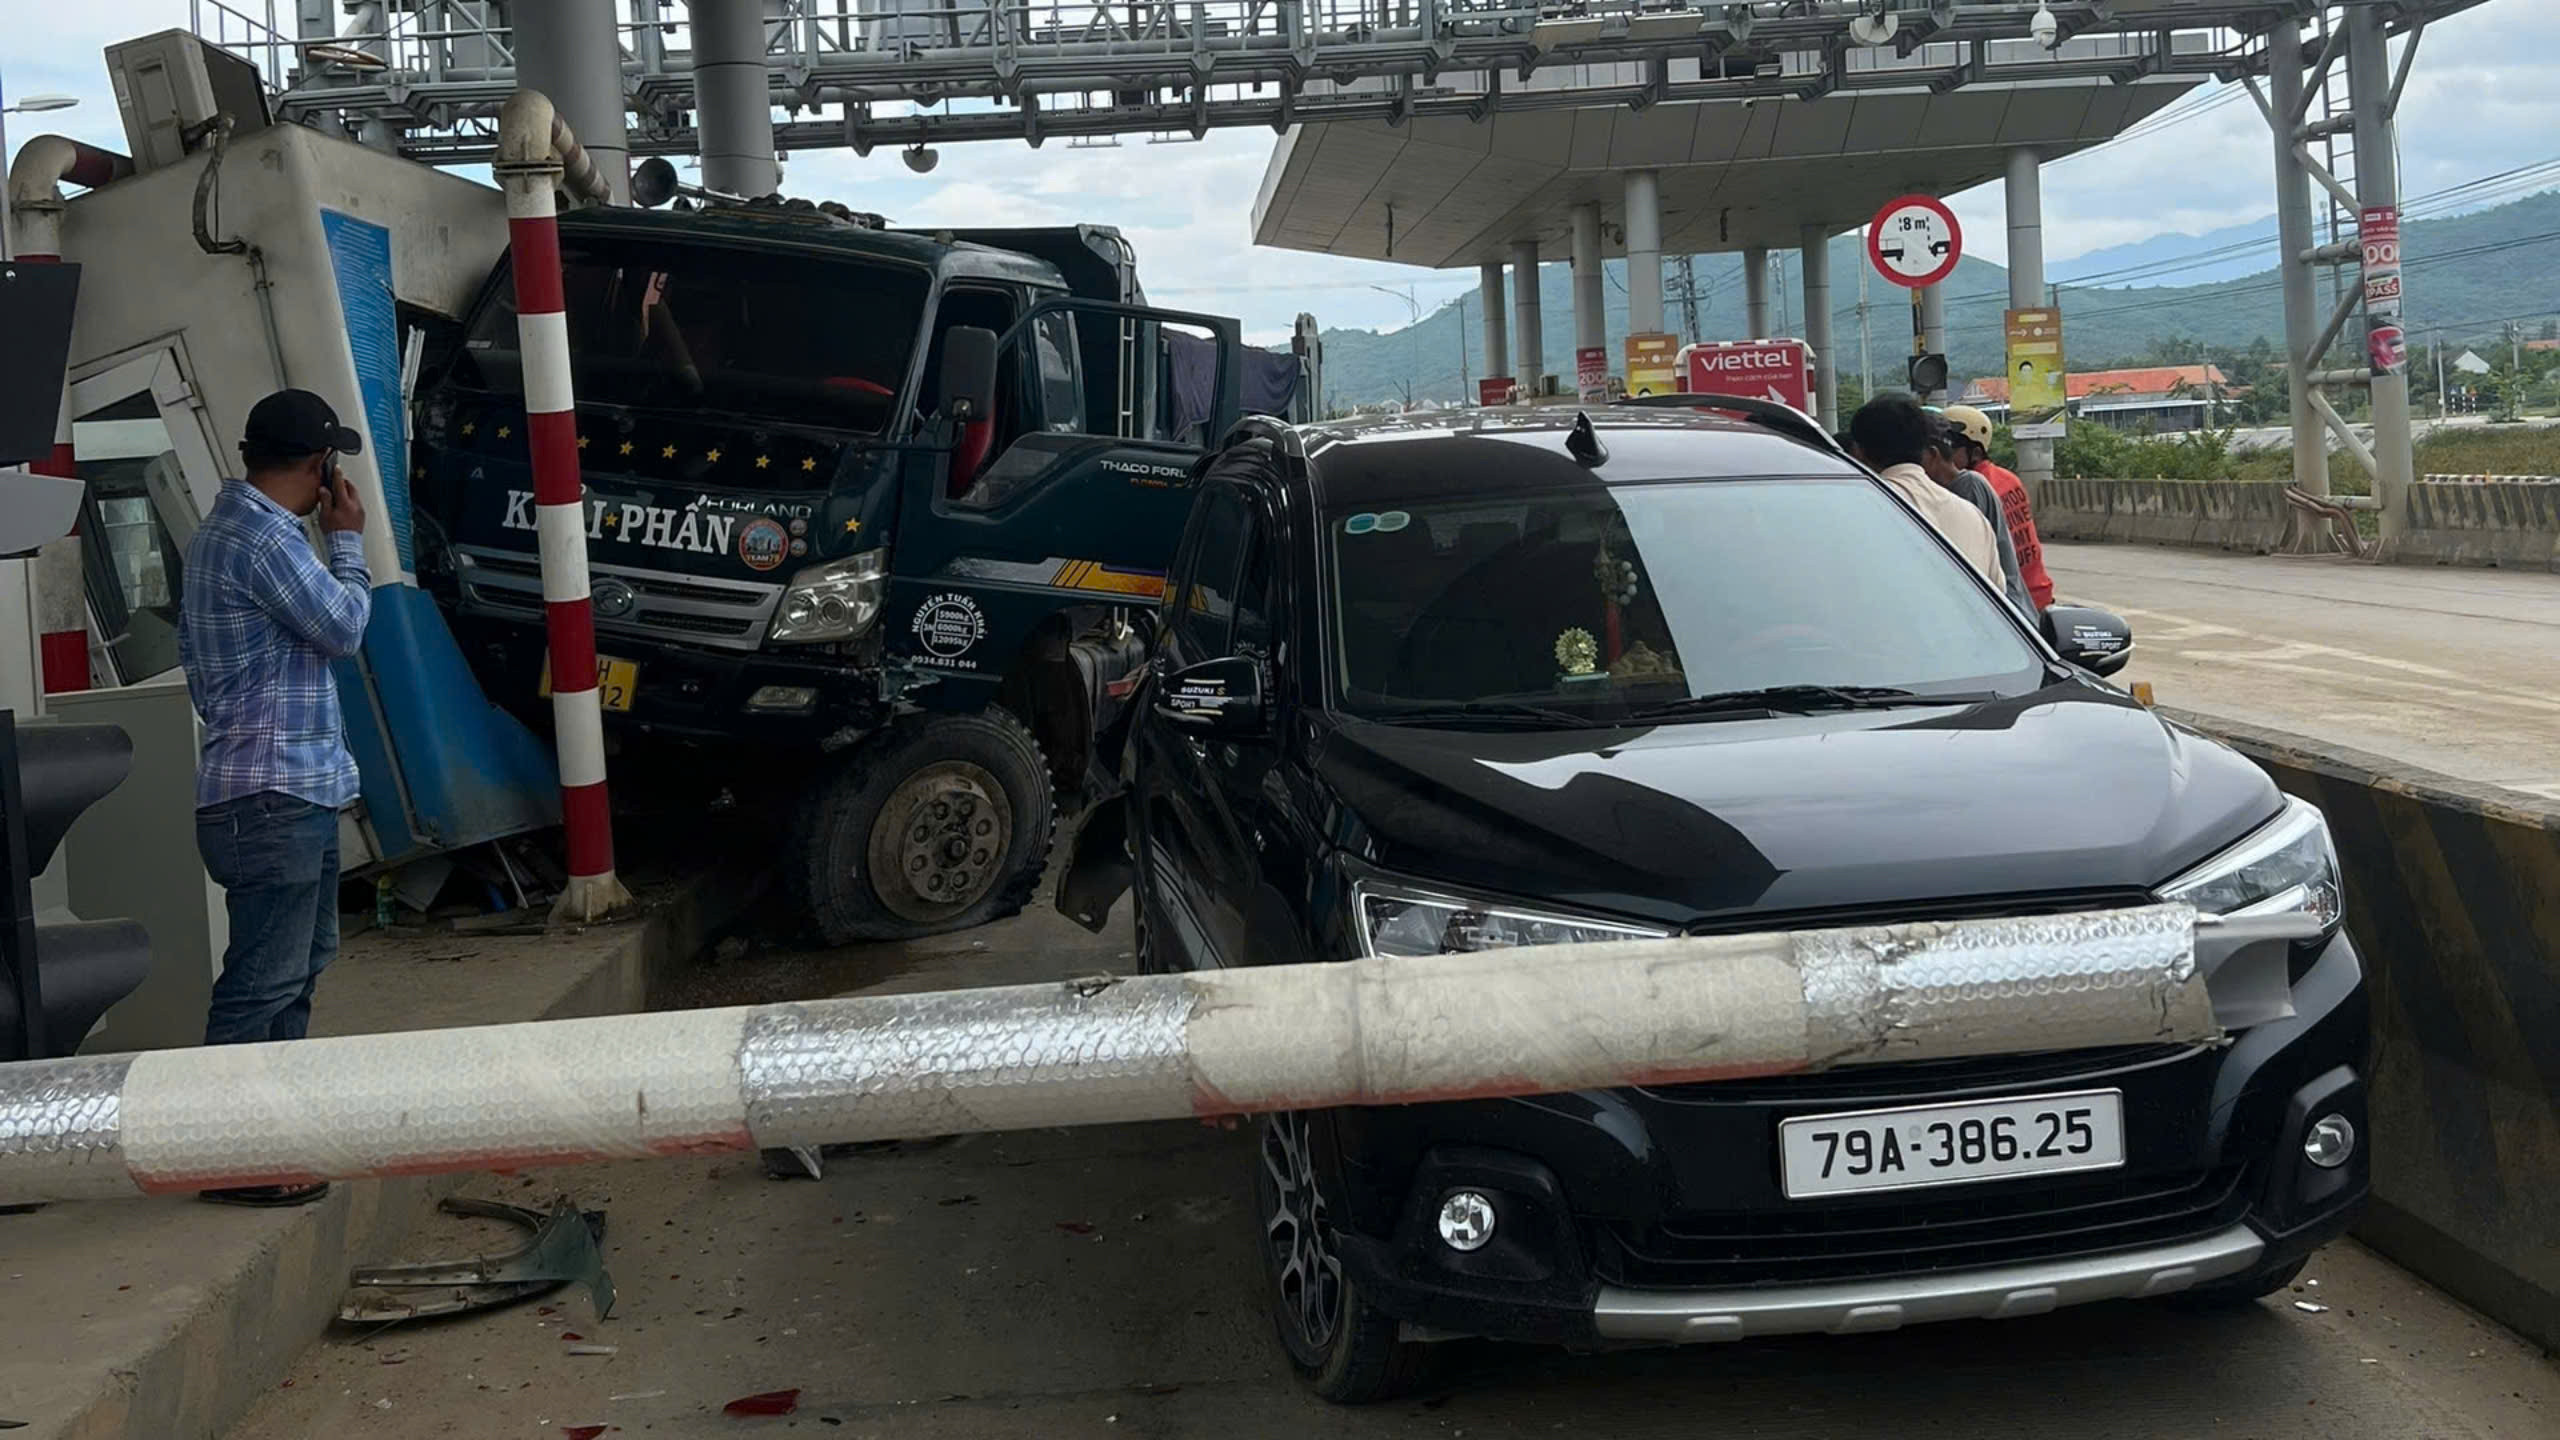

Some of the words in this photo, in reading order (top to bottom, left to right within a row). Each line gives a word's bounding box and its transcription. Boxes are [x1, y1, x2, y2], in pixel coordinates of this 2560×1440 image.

[1903, 216, 1912, 231] 8
[1915, 218, 1926, 230] m
[2363, 244, 2399, 264] 00
[1701, 349, 1792, 372] viettel
[1100, 460, 1150, 474] THACO
[706, 498, 812, 519] FORLAND
[502, 484, 608, 539] KI
[616, 494, 735, 555] PHẤN
[1180, 686, 1214, 694] SUZUKI
[1811, 1109, 2094, 1179] 79A-386.25
